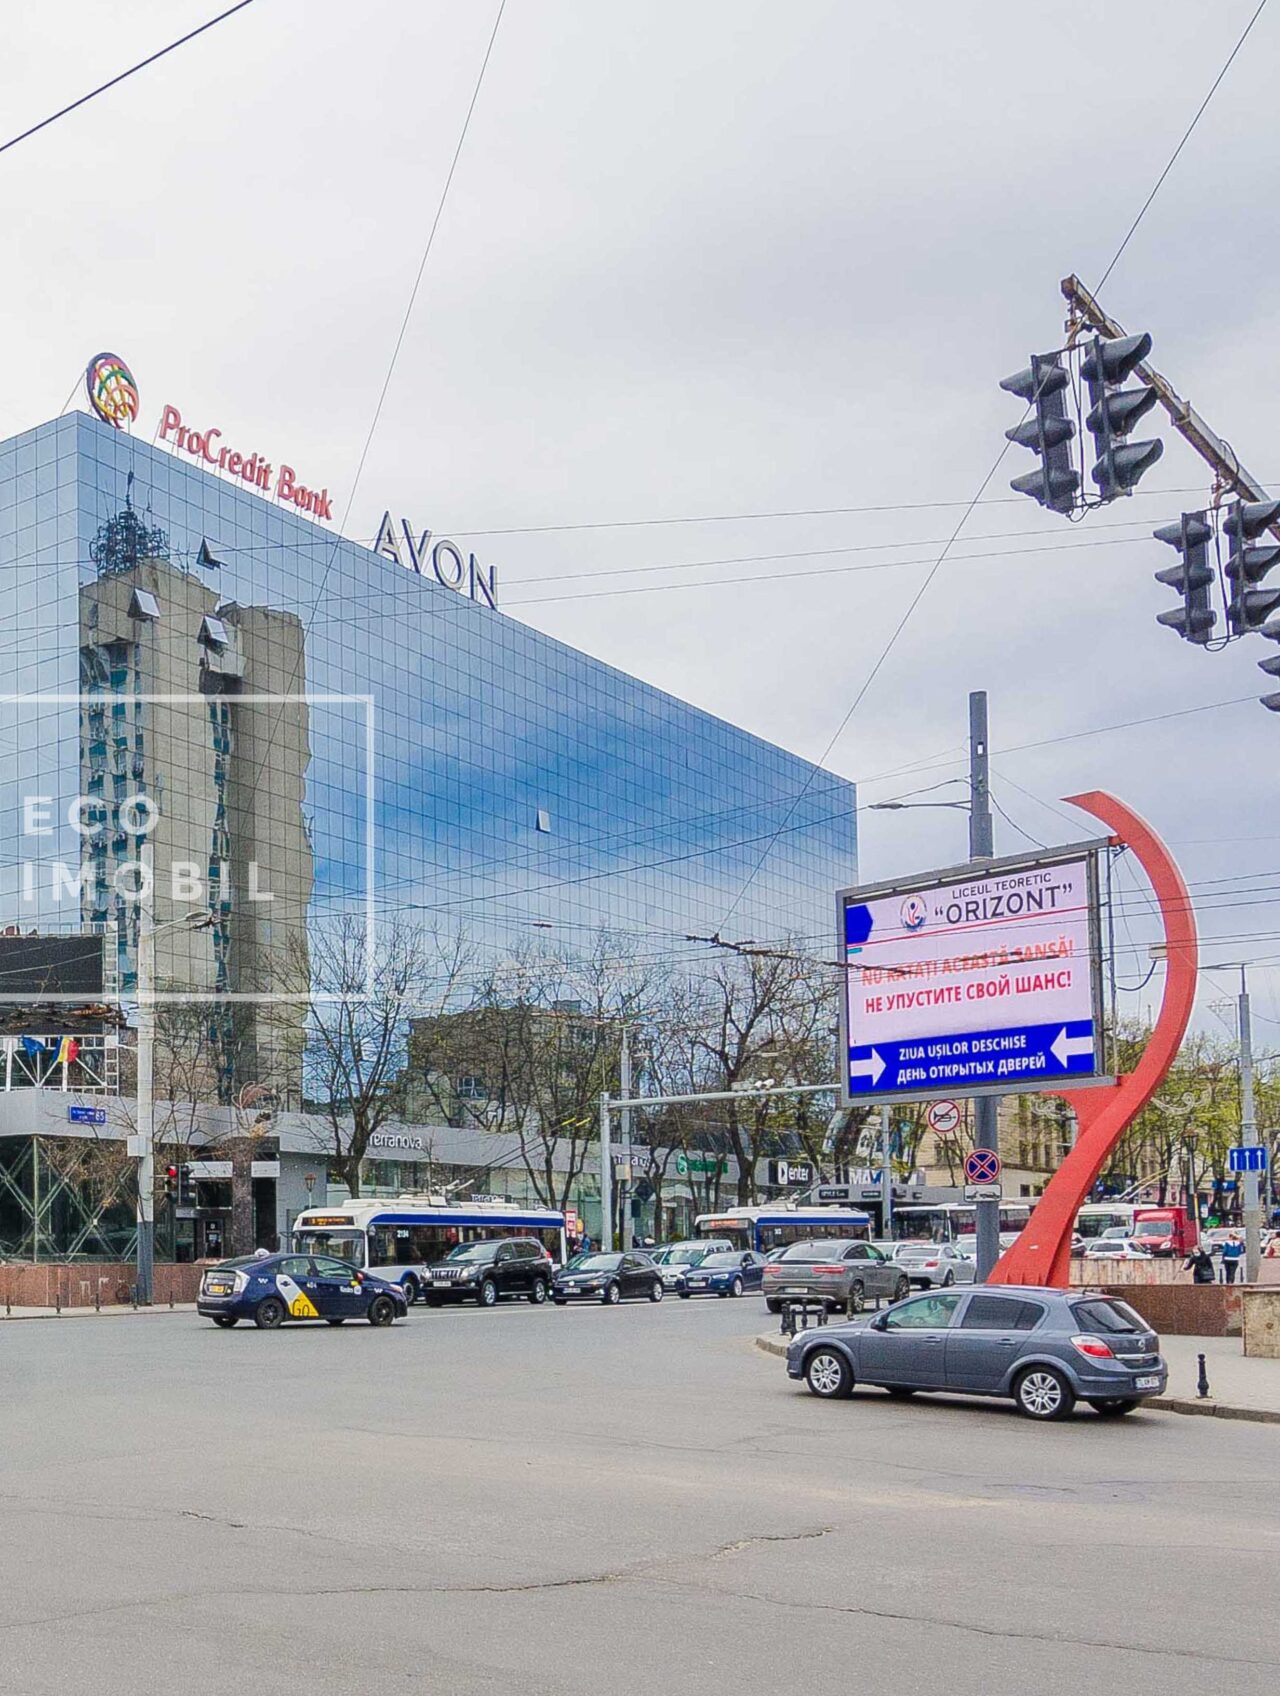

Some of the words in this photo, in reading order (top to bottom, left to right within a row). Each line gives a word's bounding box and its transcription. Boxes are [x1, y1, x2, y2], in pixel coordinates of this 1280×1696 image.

[158, 404, 273, 491] ProCredit
[277, 465, 333, 520] Bank
[373, 510, 499, 610] AVON
[952, 884, 992, 900] LICEUL
[994, 872, 1052, 892] TEORETIC
[866, 996, 883, 1014] НЕ
[886, 986, 962, 1011] УПУСТИТЕ
[966, 974, 1011, 1000] СВОЙ
[1015, 970, 1073, 994] ШАНС!
[899, 1047, 925, 1061] ZIUA
[972, 1034, 1027, 1053] DESCHISE
[897, 1066, 927, 1085] ДЕНЬ
[929, 1058, 995, 1079] ОТКРЫТЫХ
[997, 1051, 1047, 1076] ДВЕРЕЙ
[292, 1299, 310, 1317] Go
